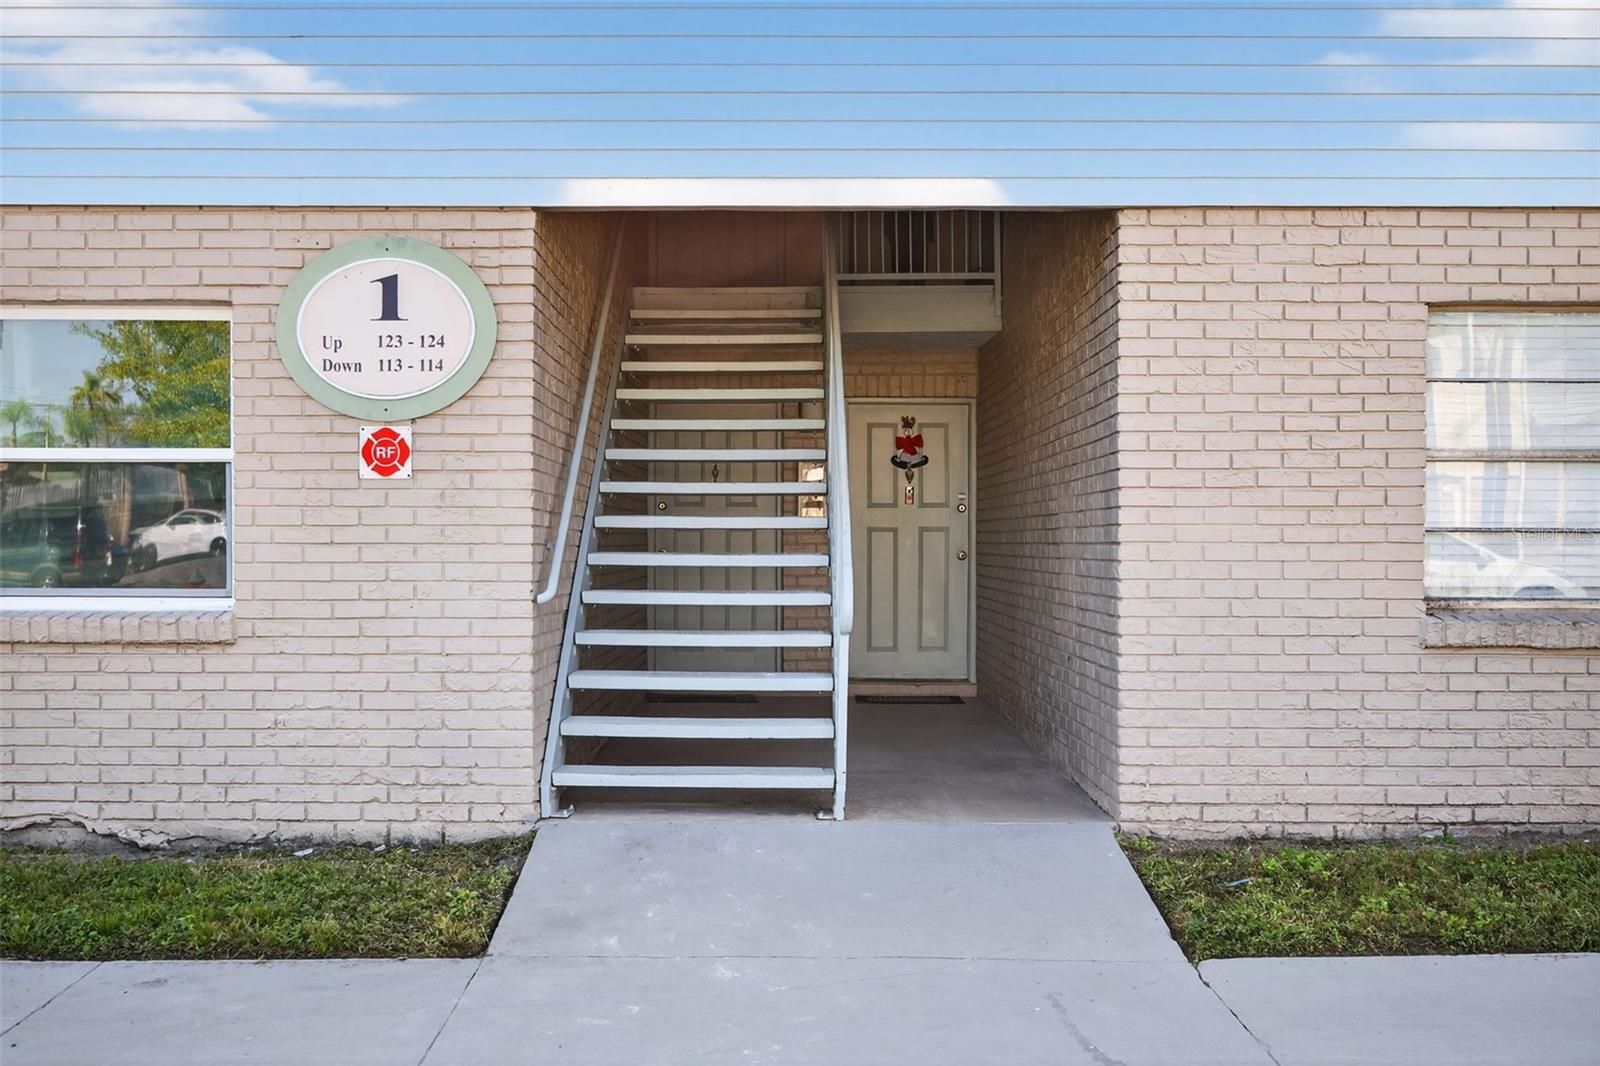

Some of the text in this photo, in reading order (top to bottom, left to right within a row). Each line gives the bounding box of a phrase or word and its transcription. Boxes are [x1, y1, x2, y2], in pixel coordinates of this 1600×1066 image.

[369, 273, 409, 322] 1
[322, 335, 343, 353] Up
[377, 335, 403, 348] 123
[420, 335, 446, 348] 124
[322, 359, 362, 373] Down
[378, 359, 403, 372] 113
[420, 359, 444, 372] 114
[376, 446, 396, 459] RF
